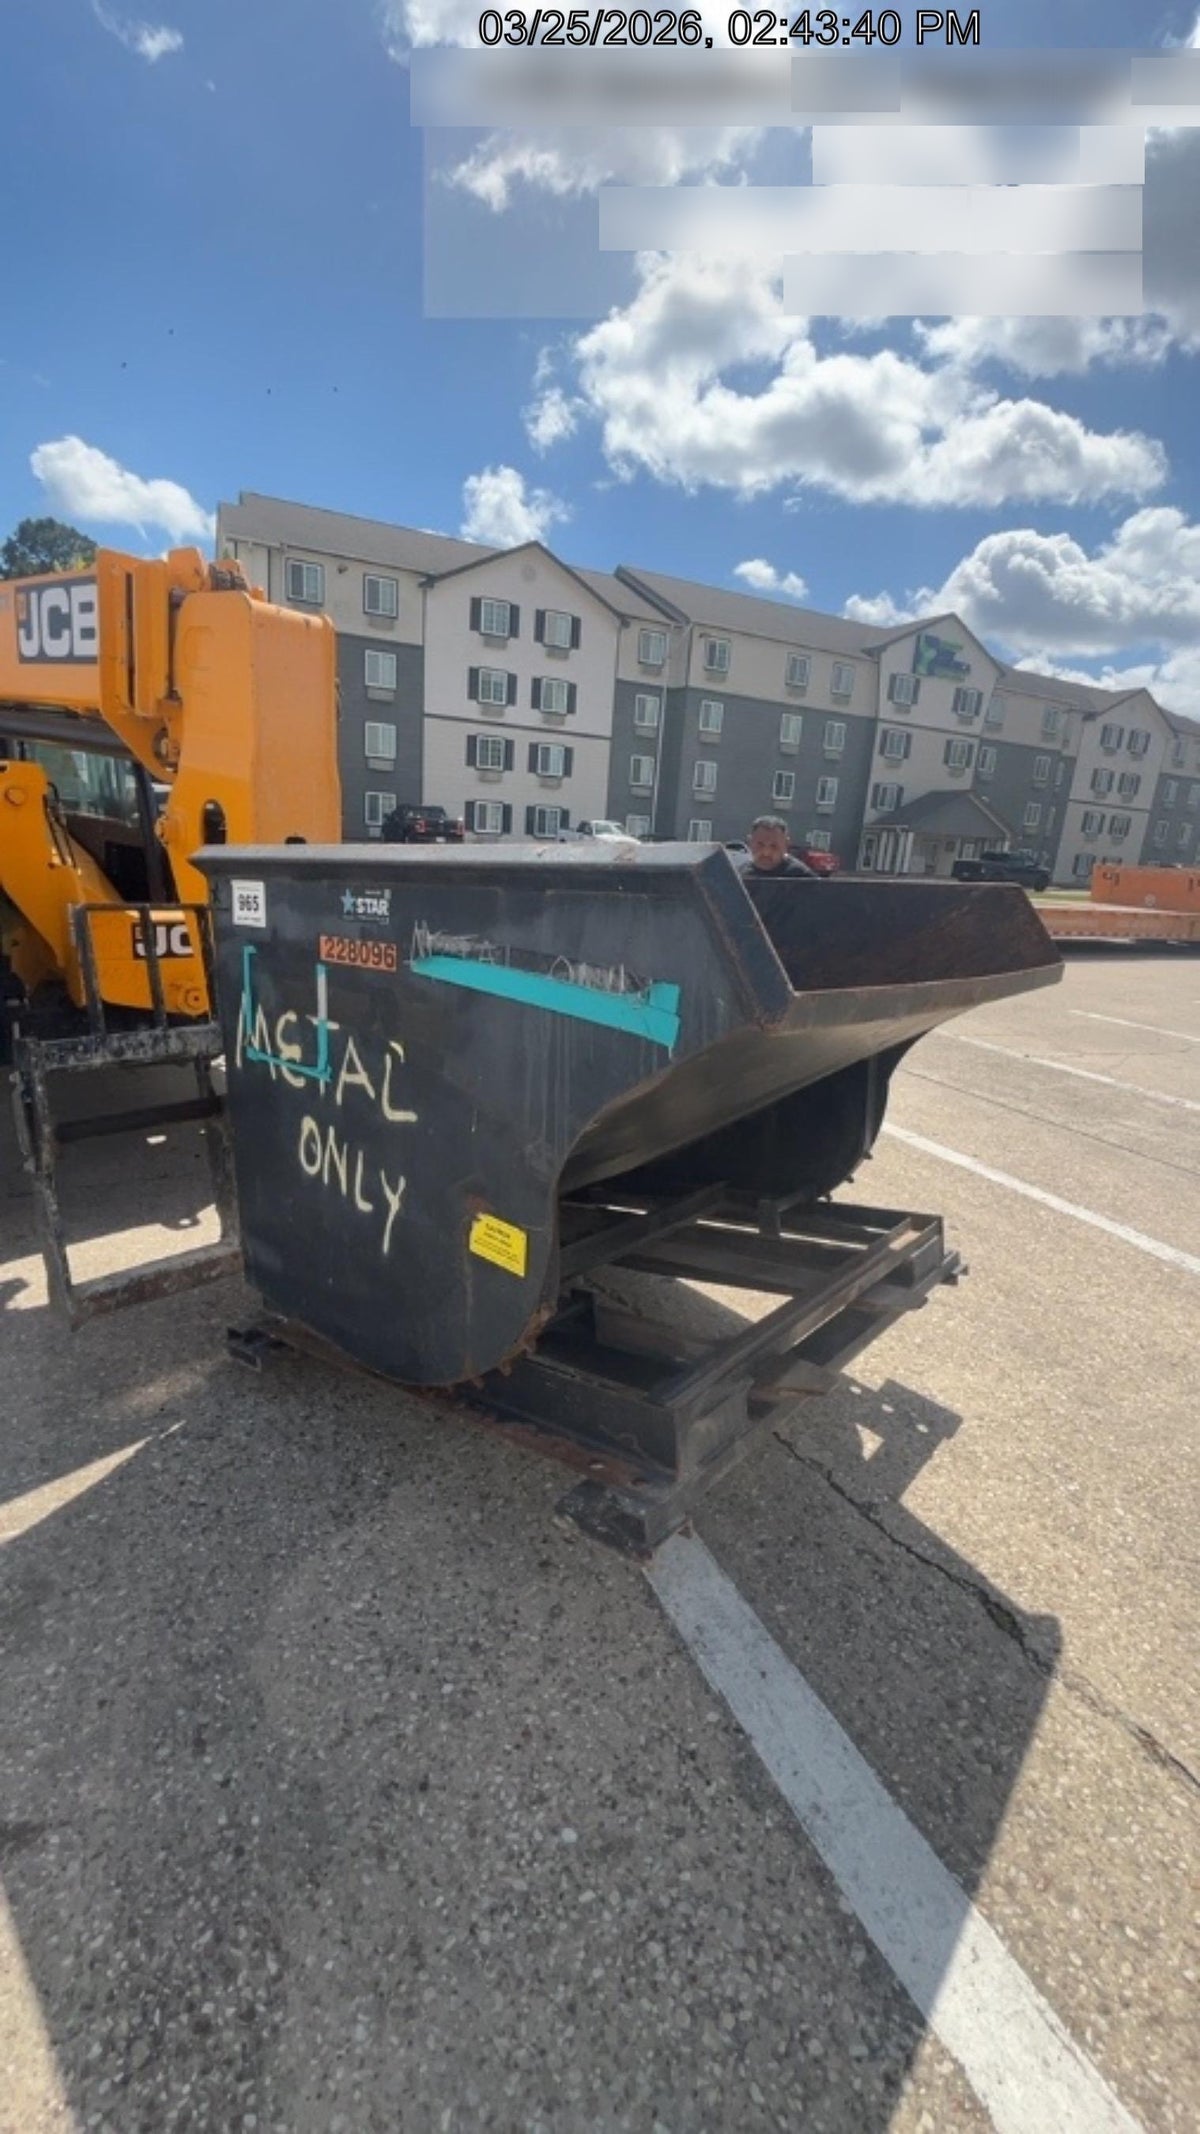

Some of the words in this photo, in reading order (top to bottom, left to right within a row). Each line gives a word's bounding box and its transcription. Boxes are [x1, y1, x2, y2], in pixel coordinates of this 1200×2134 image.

[18, 585, 98, 657] JCB
[355, 898, 390, 916] STAR
[323, 937, 395, 969] 228096
[236, 991, 418, 1122] METAL
[299, 1115, 407, 1255] ONLY
